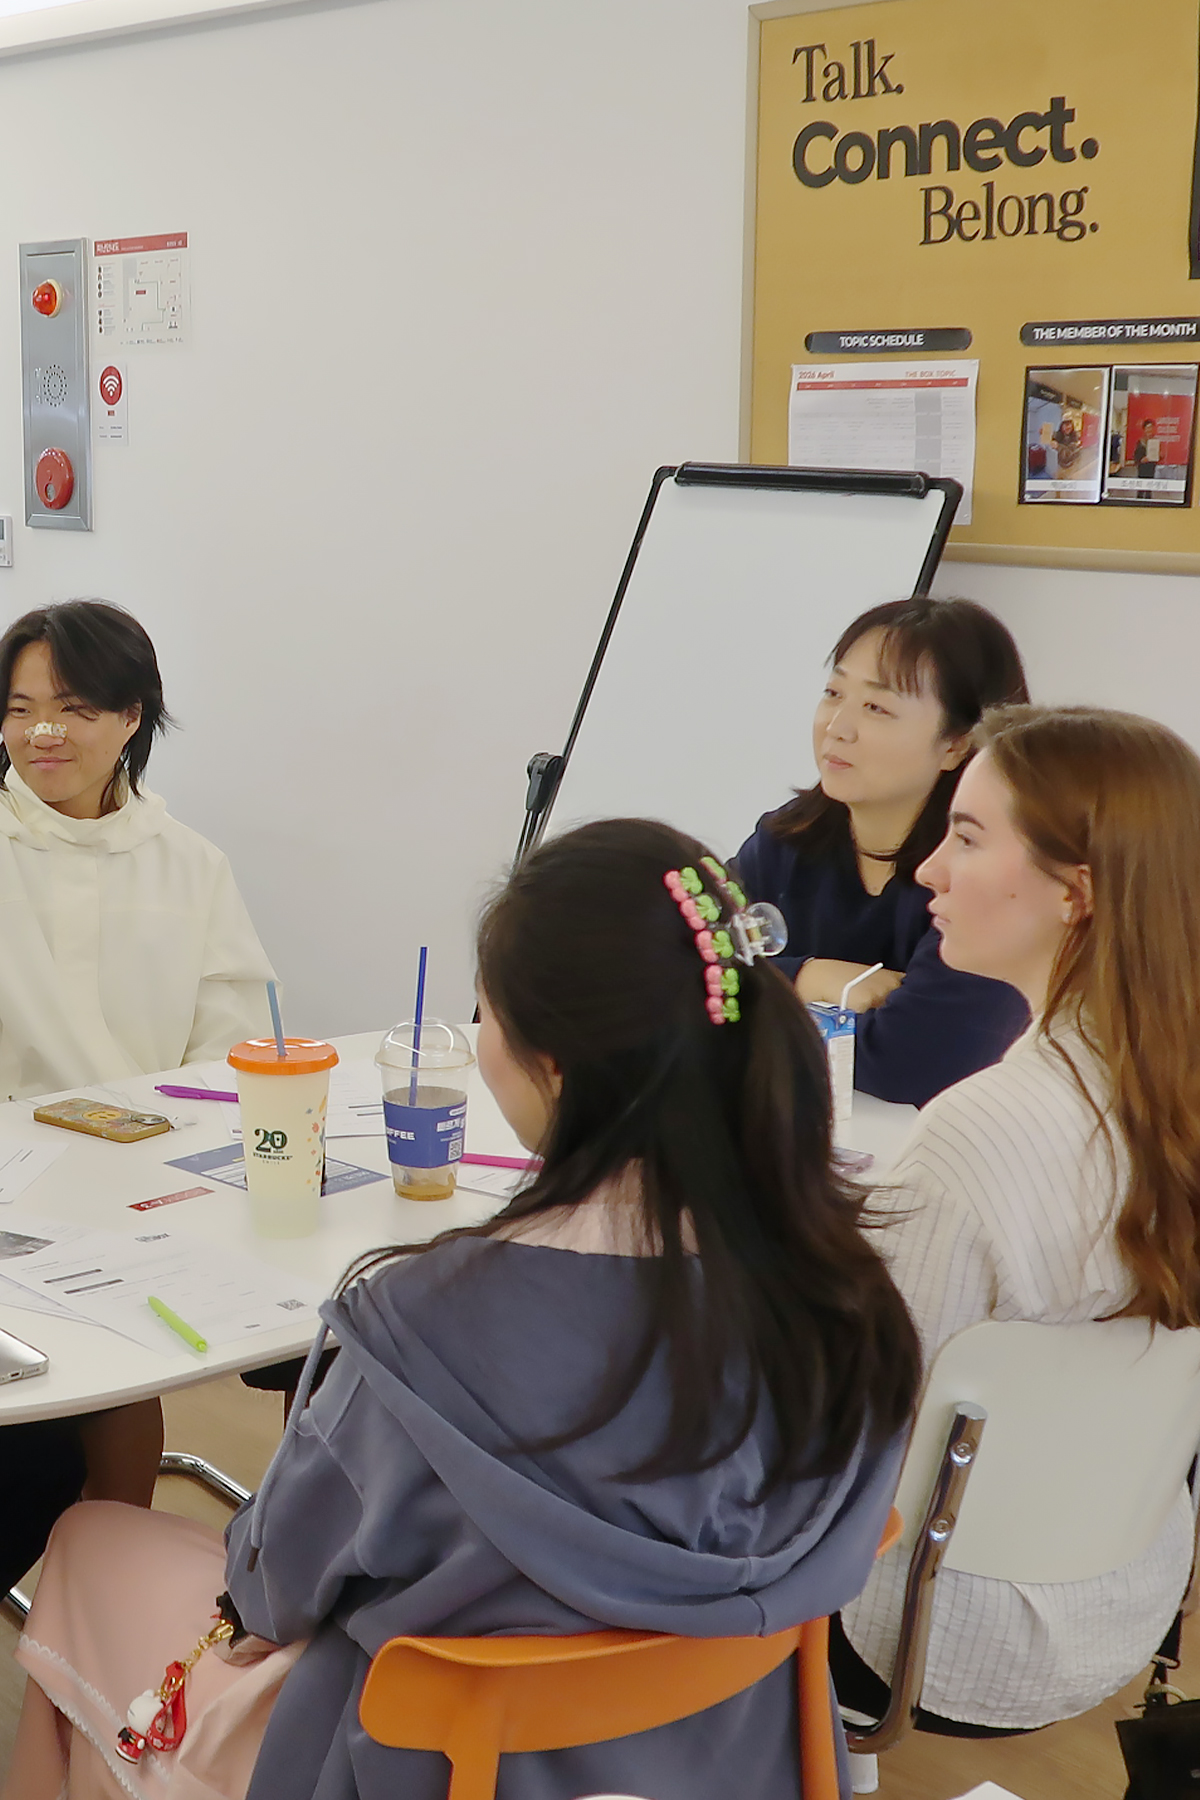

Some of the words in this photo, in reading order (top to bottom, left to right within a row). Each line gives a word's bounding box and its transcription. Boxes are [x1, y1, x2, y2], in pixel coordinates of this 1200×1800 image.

[791, 38, 905, 103] Talk.
[793, 96, 1099, 188] Connect.
[919, 181, 1099, 245] Belong.
[839, 335, 869, 348] TOPIC
[869, 333, 925, 347] SCHEDULE
[1033, 327, 1056, 340] THE
[1056, 325, 1106, 339] MEMBER
[1107, 325, 1124, 338] OF
[1125, 324, 1150, 338] THE
[1150, 322, 1197, 336] MONTH
[817, 370, 835, 380] April
[254, 1128, 288, 1153] 20
[253, 1152, 293, 1161] STARBUCKS
